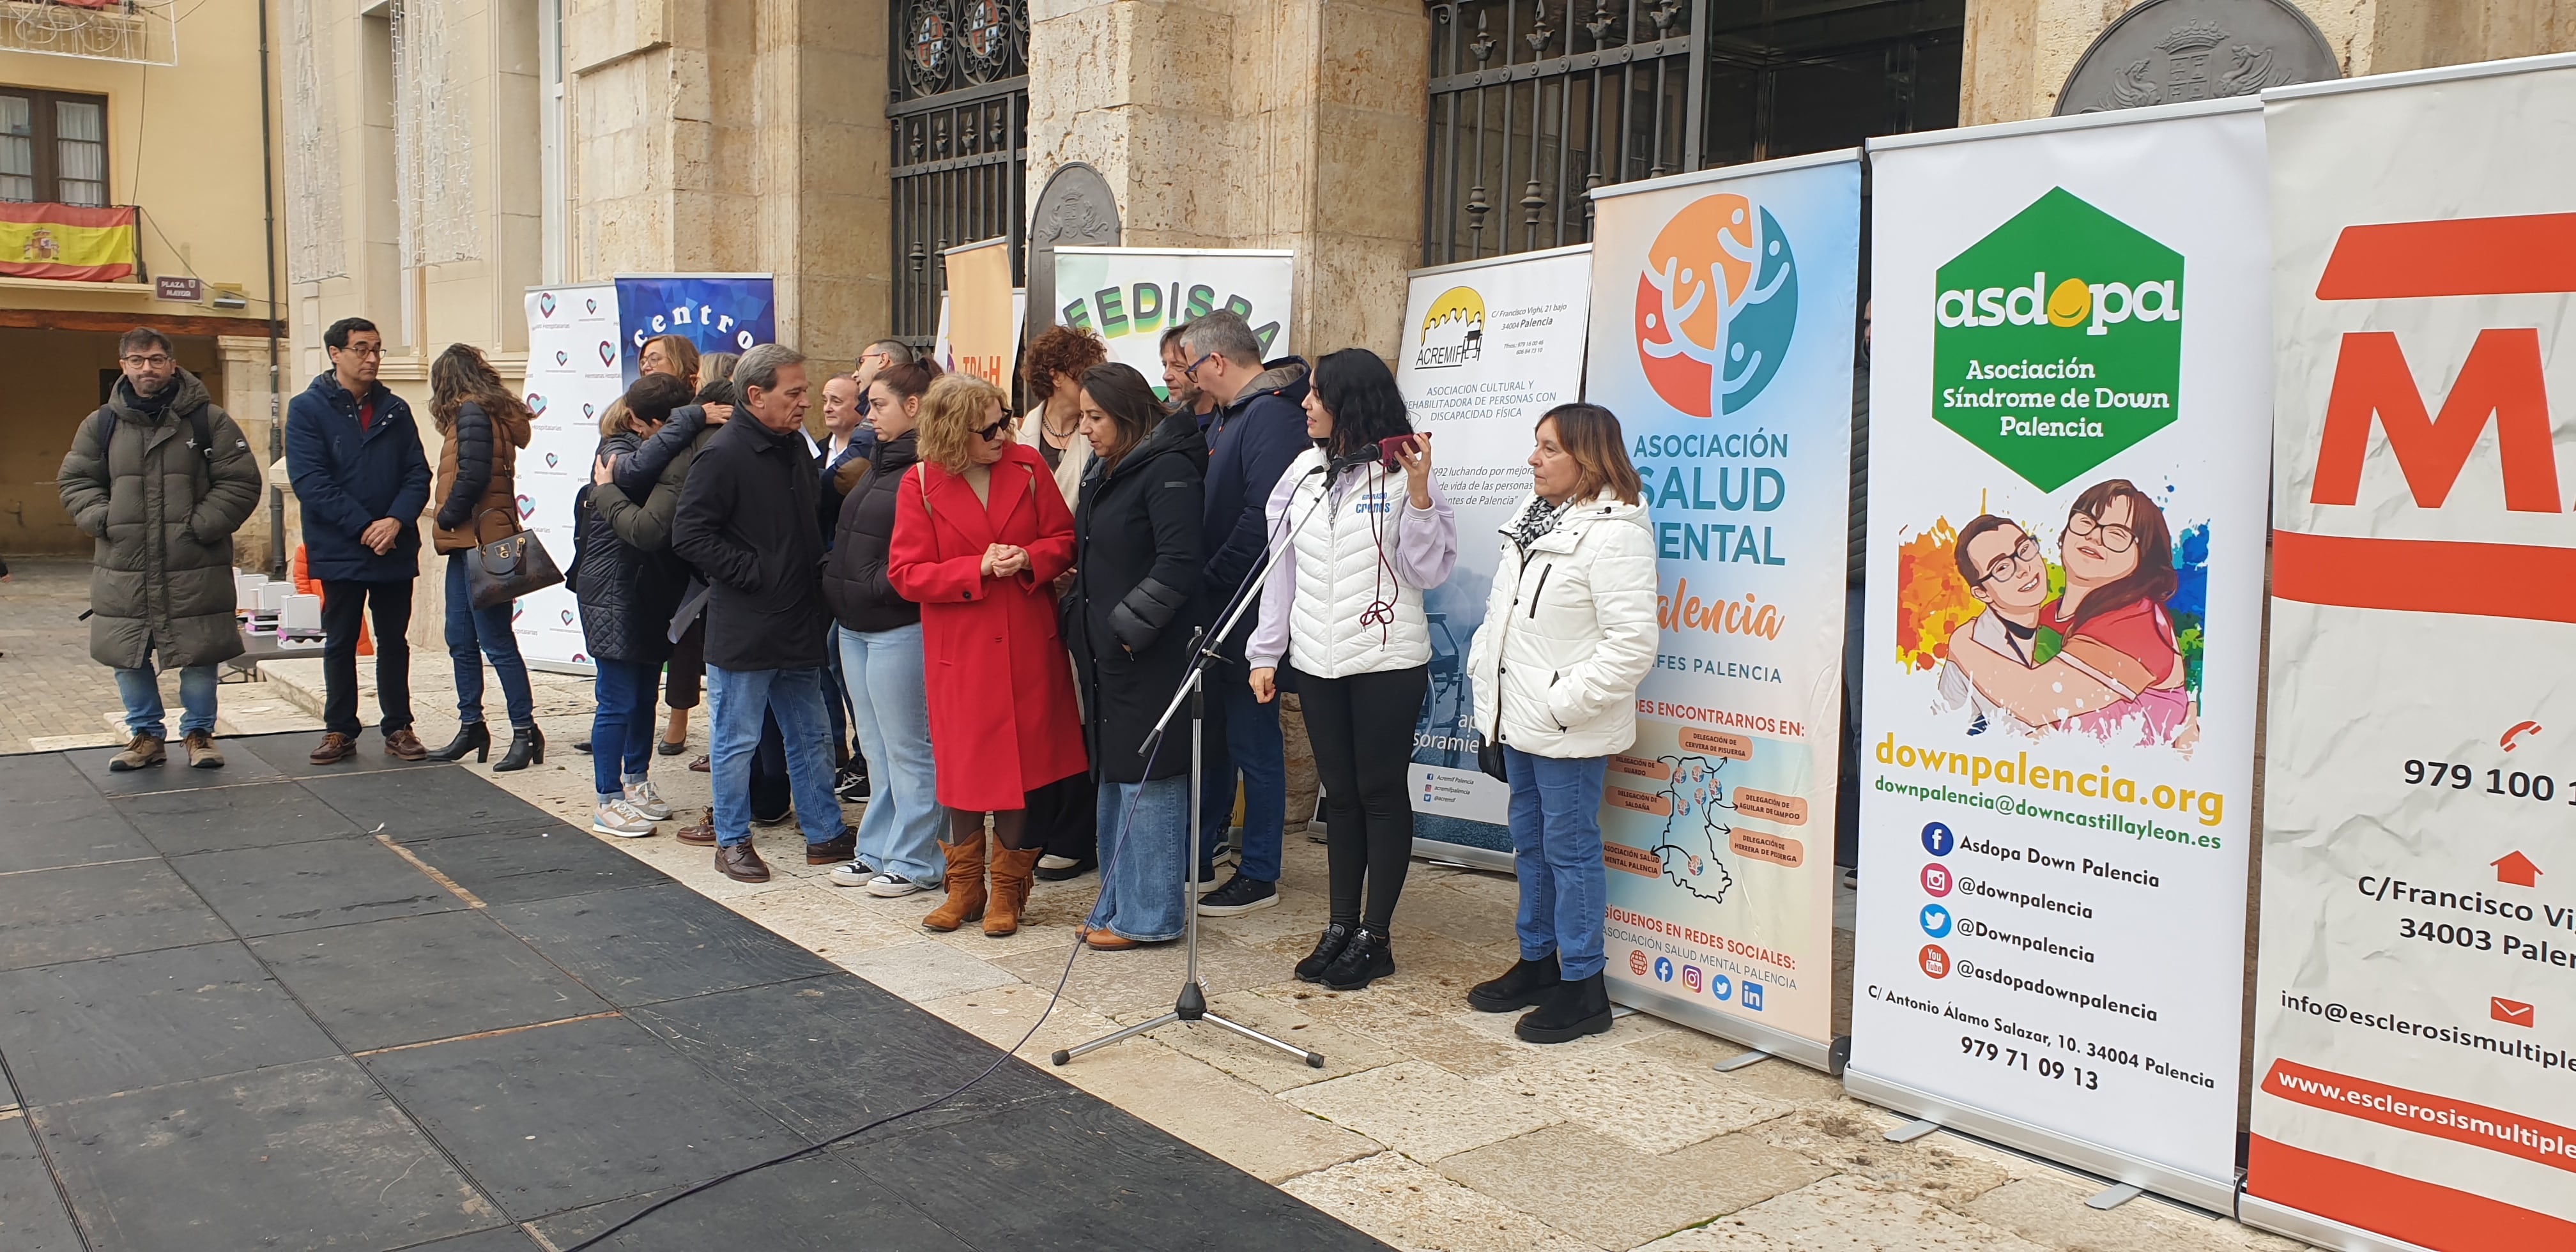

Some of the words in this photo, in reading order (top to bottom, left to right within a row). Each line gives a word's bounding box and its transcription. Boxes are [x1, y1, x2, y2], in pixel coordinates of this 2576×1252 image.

[1499, 309, 1526, 317] Francisco
[1553, 303, 1567, 312] bajo
[1936, 271, 2180, 335] asdopa
[634, 305, 754, 350] centro
[1501, 321, 1520, 330] 34004
[1520, 317, 1553, 328] Palencia
[1966, 357, 2096, 379] Asociación
[1427, 384, 1478, 397] ASOCIACION
[1480, 380, 1526, 393] CULTURAL
[1528, 379, 1535, 390] Y
[1943, 386, 2056, 408] Síndrome
[2060, 388, 2090, 408] de
[2094, 388, 2170, 409] Down
[1475, 396, 1487, 406] DE
[1489, 393, 1533, 406] PERSONAS
[1536, 392, 1557, 402] CON
[1430, 409, 1493, 422] DISCAPACIDAD
[1496, 406, 1522, 418] FÍSICA
[2000, 416, 2104, 438] Palencia
[1634, 427, 1788, 458] ASOCIACIÓN
[1448, 466, 1488, 477] luchando
[1489, 468, 1505, 478] por
[1439, 481, 1449, 491] de
[1450, 481, 1466, 491] vida
[1468, 480, 1480, 491] de
[1482, 480, 1494, 491] las
[1494, 481, 1533, 492] personas
[1635, 466, 1786, 512] SALUD
[1466, 495, 1478, 505] de
[1478, 495, 1519, 505] Palencia"
[1652, 521, 1786, 566] ENTAL
[1651, 653, 1687, 671] FES
[1693, 659, 1782, 683] PALENCIA
[1658, 701, 1775, 733] ENCONTRARNOS
[1779, 720, 1805, 737] EN:
[1685, 741, 1709, 752] CERVERA
[1718, 747, 1746, 757] PISUERGA
[1693, 733, 1728, 745] DELEGACIÓN
[1616, 756, 1646, 767] DELEGACIÓN
[1623, 767, 1646, 776] GUARDO
[1454, 777, 1475, 785] Palencia
[1876, 731, 2223, 827] downpalencia.org
[2404, 759, 2472, 790] 979
[2486, 768, 2554, 802] 100
[1434, 786, 1471, 795] acremifpalencia
[1618, 790, 1649, 802] DELEGACIÓN
[1745, 794, 1781, 807] DELEGACIÓN
[1625, 800, 1650, 811] SALDAÑA
[1739, 802, 1765, 813] AGUILAR
[1774, 809, 1800, 820] CAMPOO
[1875, 775, 2221, 849] downpalencia@downcastillayleon.es
[1734, 843, 1759, 854] HERRERA
[1742, 835, 1778, 848] DELEGACIÓN
[1604, 844, 1639, 859] ASOCIACIÓN
[1639, 853, 1659, 864] SALUD
[1959, 835, 2021, 861] Asdopa
[2027, 848, 2075, 871] Down
[2082, 858, 2159, 888] Palencia
[1604, 855, 1627, 867] MENTAL
[1629, 862, 1658, 874] PALENCIA
[1958, 876, 2092, 919] @downpalencia
[2358, 876, 2534, 921] C/Francisco
[2543, 905, 2576, 935] Vi
[1604, 905, 1662, 933] SÍGUENOS
[1666, 923, 1682, 938] EN
[1685, 928, 1724, 950] REDES
[1728, 940, 1797, 970] SOCIALES:
[1957, 918, 2095, 963] @Downpalencia
[2400, 918, 2492, 951] 34003
[1602, 927, 1662, 952] ASOCIACIÓN
[1664, 943, 1697, 961] SALUD
[1699, 953, 1742, 975] MENTAL
[1744, 965, 1798, 991] PALENCIA
[1927, 947, 1942, 961] You
[1927, 961, 1942, 973] Tube
[1957, 959, 2158, 1022] @asdopadownpalencia
[1868, 984, 1883, 1001] C/
[1885, 989, 1939, 1015] Antonio
[1943, 1001, 1989, 1028] Álamo
[1994, 1018, 2051, 1048] Salazar,
[2058, 1034, 2082, 1053] 10.
[2086, 1042, 2139, 1068] 34004
[2145, 1057, 2215, 1089] Palencia
[1961, 1036, 1998, 1061] 979
[2005, 1048, 2028, 1071] 71
[2038, 1057, 2064, 1080] 09
[2074, 1067, 2099, 1090] 13
